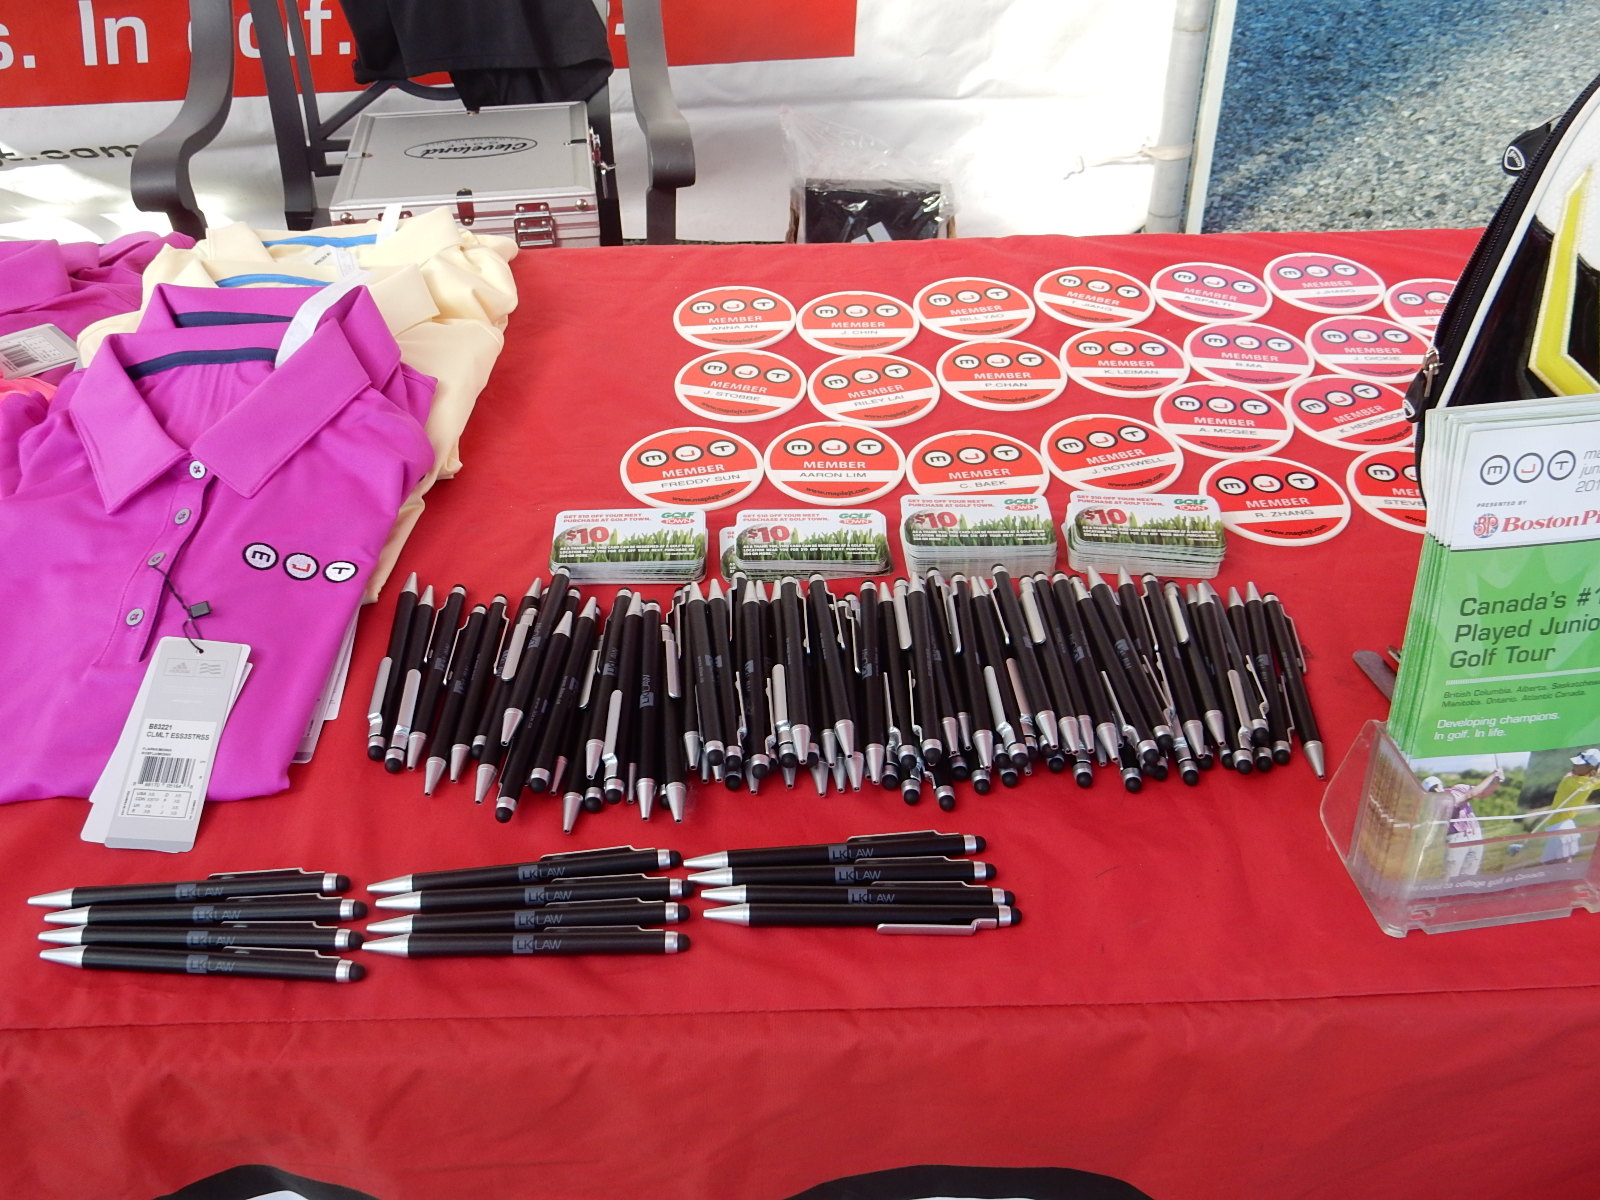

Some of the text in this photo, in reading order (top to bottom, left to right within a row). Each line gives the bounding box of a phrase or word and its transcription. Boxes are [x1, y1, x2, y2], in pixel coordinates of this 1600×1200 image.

[79, 0, 149, 66] In
[420, 141, 528, 158] Cleveland
[1301, 280, 1353, 289] MEMBER
[1066, 290, 1120, 306] MEMBER
[1183, 287, 1237, 302] MEMBER
[950, 305, 1003, 316] MEMBER
[708, 315, 762, 324] MEMBER
[1221, 352, 1278, 362] MEMBER
[710, 380, 768, 394] MEMBER
[847, 384, 904, 400] MEMBER
[717, 391, 761, 402] STOBBE
[853, 396, 885, 408] RILEY
[1333, 405, 1385, 423] MEMBER
[1194, 417, 1255, 427] MEMBER
[803, 461, 866, 469] MEMBER
[1085, 449, 1145, 466] MEMBER
[1102, 457, 1165, 473] ROTHWELL
[662, 464, 725, 478] MEMBER
[948, 468, 1010, 480] MEMBER
[661, 473, 741, 489] FREDDY SUN
[1246, 497, 1311, 508] MEMBER
[914, 511, 957, 528] $10
[1084, 508, 1128, 525] $10
[1270, 509, 1315, 517] ZHANG
[566, 526, 609, 544] $10
[747, 525, 790, 542] $10
[1460, 590, 1567, 616] Canada's
[1455, 619, 1532, 645] Played
[1449, 645, 1556, 668] Golf Tour
[1443, 691, 1471, 699] British
[1521, 693, 1552, 702] Atlantic
[1437, 712, 1560, 729] Developing champions.
[1434, 732, 1444, 740] In
[1474, 729, 1485, 738] In
